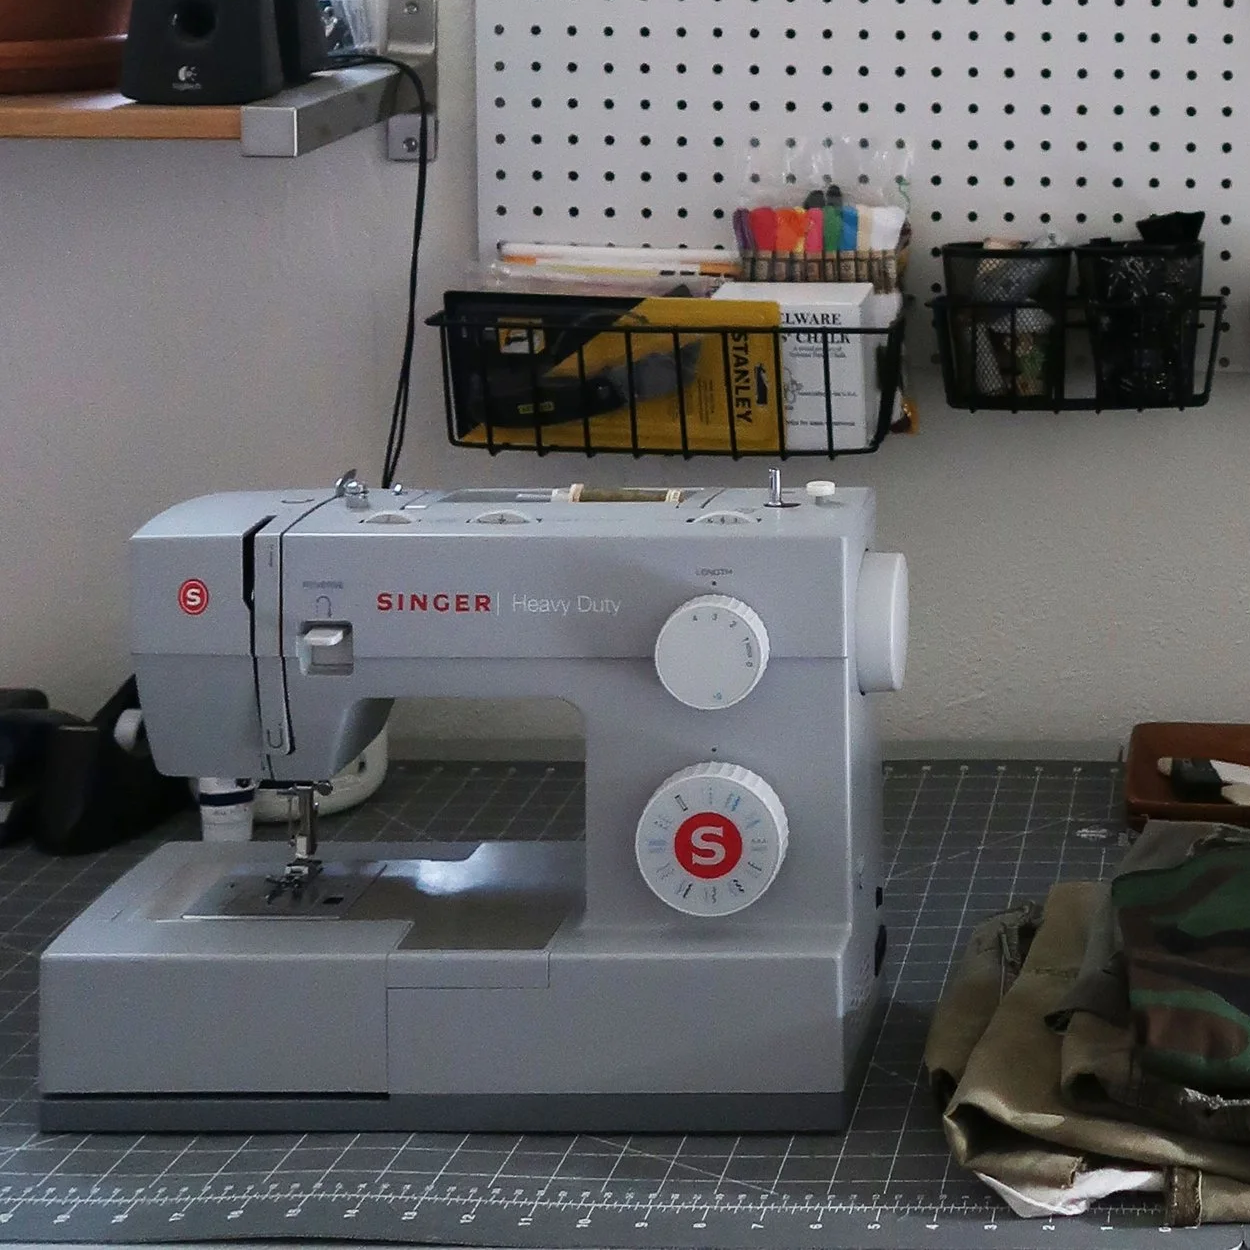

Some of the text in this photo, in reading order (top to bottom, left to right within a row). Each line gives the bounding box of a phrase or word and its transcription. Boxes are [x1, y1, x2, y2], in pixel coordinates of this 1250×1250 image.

[781, 313, 842, 325] LWARE
[796, 333, 851, 344] CHLK
[731, 332, 753, 424] STANLEY
[186, 588, 201, 606] S
[376, 593, 621, 617] SINGER Heavy Duty
[690, 825, 726, 866] S
